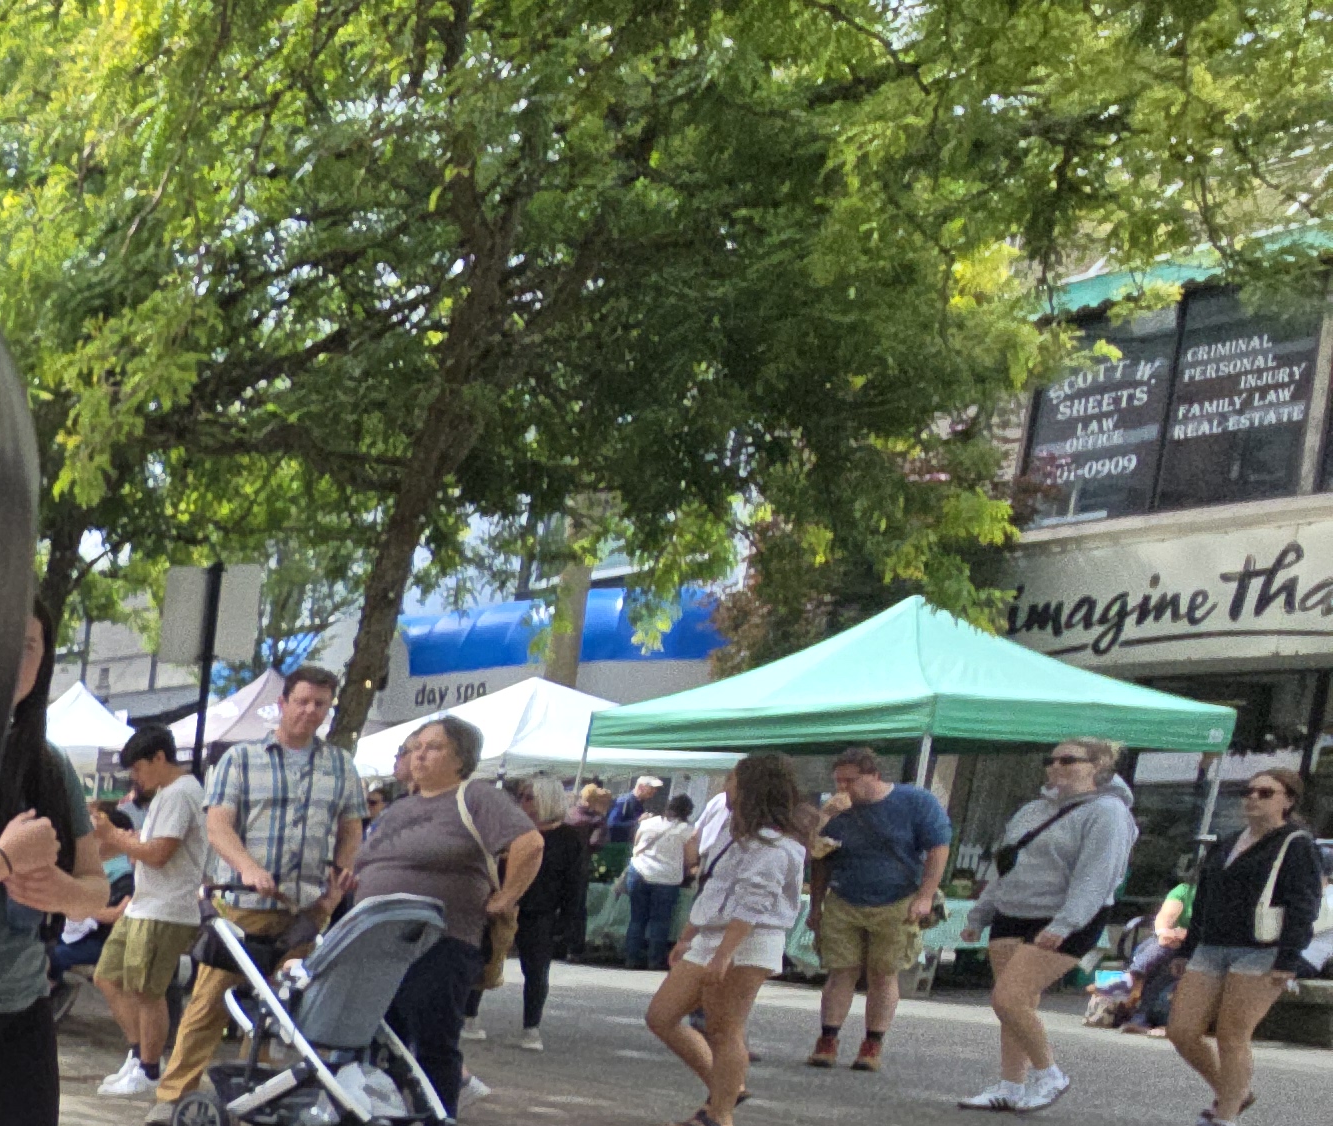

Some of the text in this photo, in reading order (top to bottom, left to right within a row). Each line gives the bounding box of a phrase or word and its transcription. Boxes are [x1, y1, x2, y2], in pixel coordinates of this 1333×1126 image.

[1186, 334, 1272, 362] CRIMINAL
[1049, 360, 1130, 404] SCOTT
[1183, 354, 1277, 382] PERSONAL
[1240, 362, 1308, 389] INJURY
[1056, 386, 1148, 420] SHEETS
[1178, 384, 1295, 420] FAMILY LAW
[1077, 413, 1119, 436] LAW
[1173, 402, 1305, 440] REAL ESTATE
[1065, 428, 1124, 452] OFFICE
[1005, 573, 1217, 654] imagine
[414, 680, 487, 709] day spa
